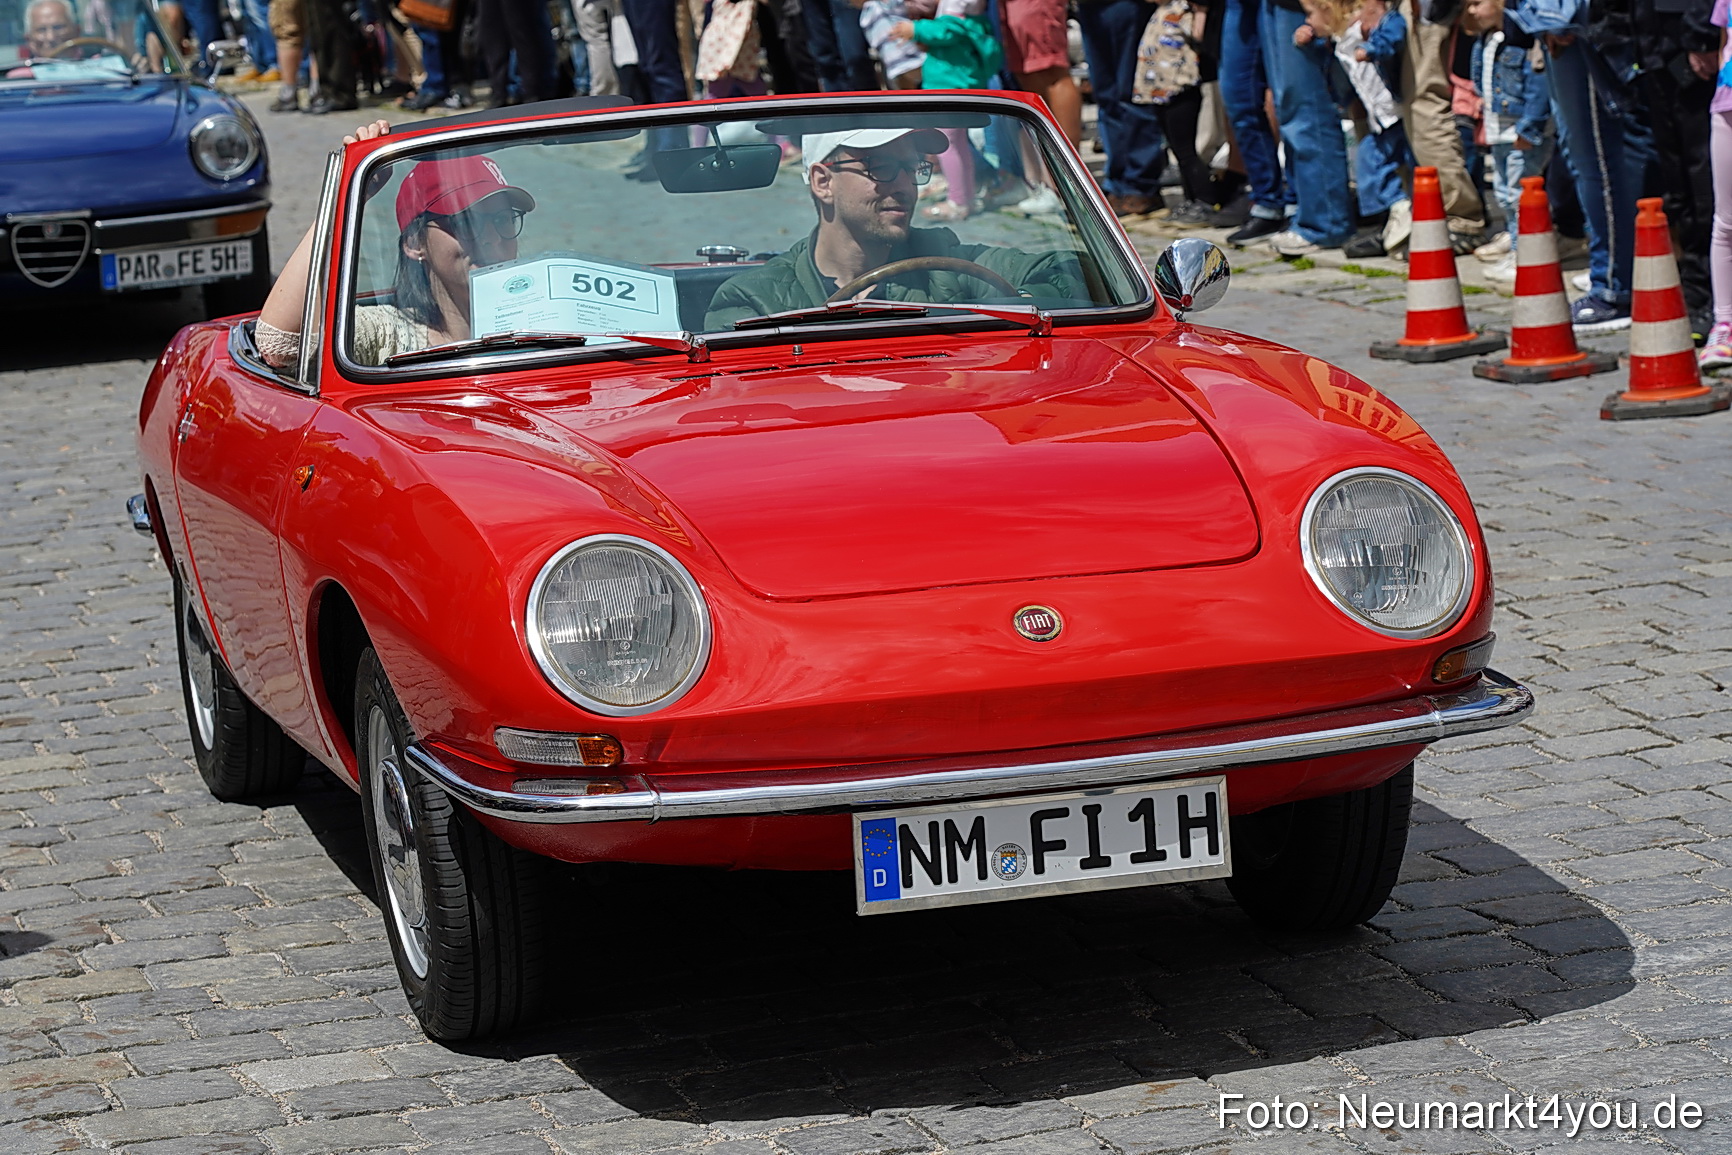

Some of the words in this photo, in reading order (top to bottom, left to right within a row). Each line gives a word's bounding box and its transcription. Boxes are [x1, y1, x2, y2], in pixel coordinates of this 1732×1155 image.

[119, 254, 160, 281] PAR
[178, 249, 205, 275] FE
[211, 245, 238, 273] 5H
[571, 272, 636, 302] 502
[1022, 614, 1051, 630] FIAT
[898, 815, 988, 889] NM
[1029, 803, 1112, 876] FI
[1127, 791, 1220, 865] 1H
[873, 869, 887, 887] D
